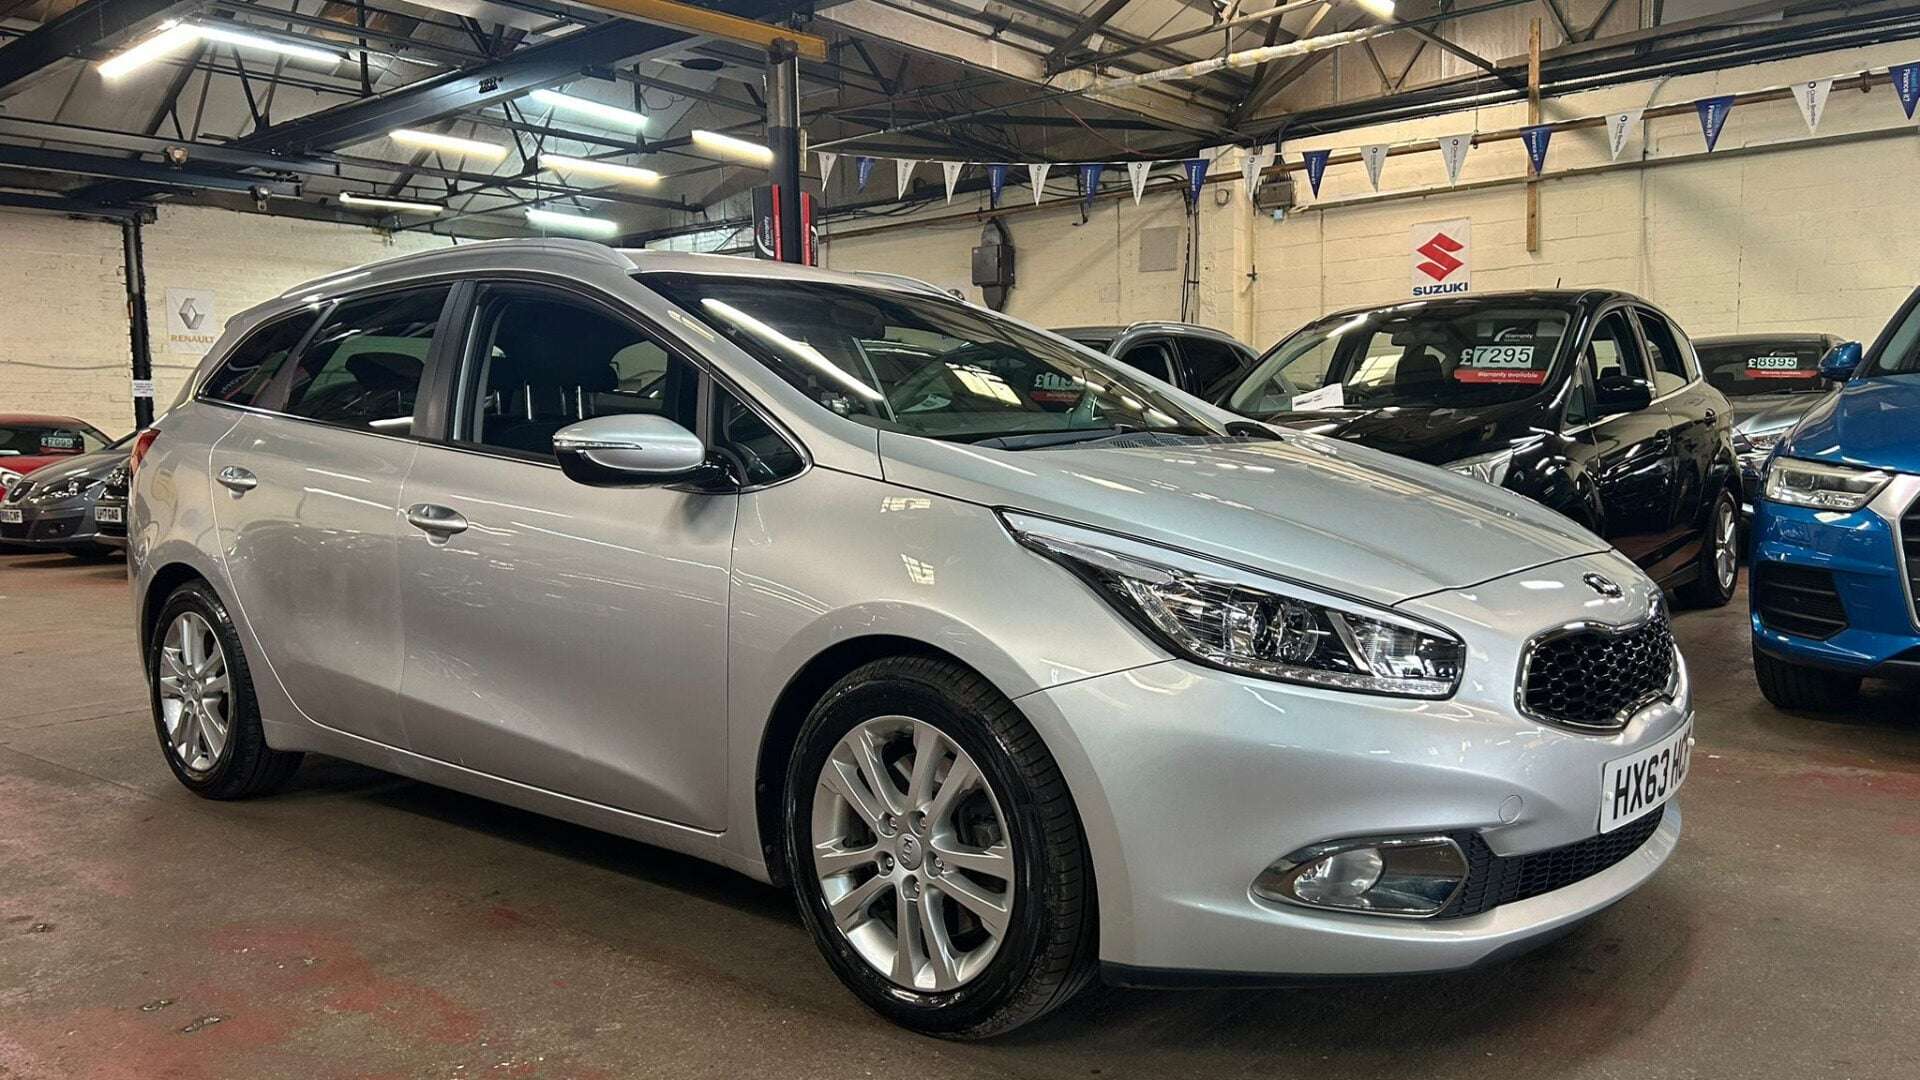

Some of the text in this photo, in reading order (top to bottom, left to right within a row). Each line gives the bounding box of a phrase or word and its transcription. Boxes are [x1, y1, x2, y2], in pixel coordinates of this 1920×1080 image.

[1412, 282, 1468, 296] SUZUKI
[170, 335, 214, 343] RENAULT
[1460, 347, 1531, 365] £7295
[1747, 358, 1796, 368] £8995
[1613, 748, 1670, 820] HX63
